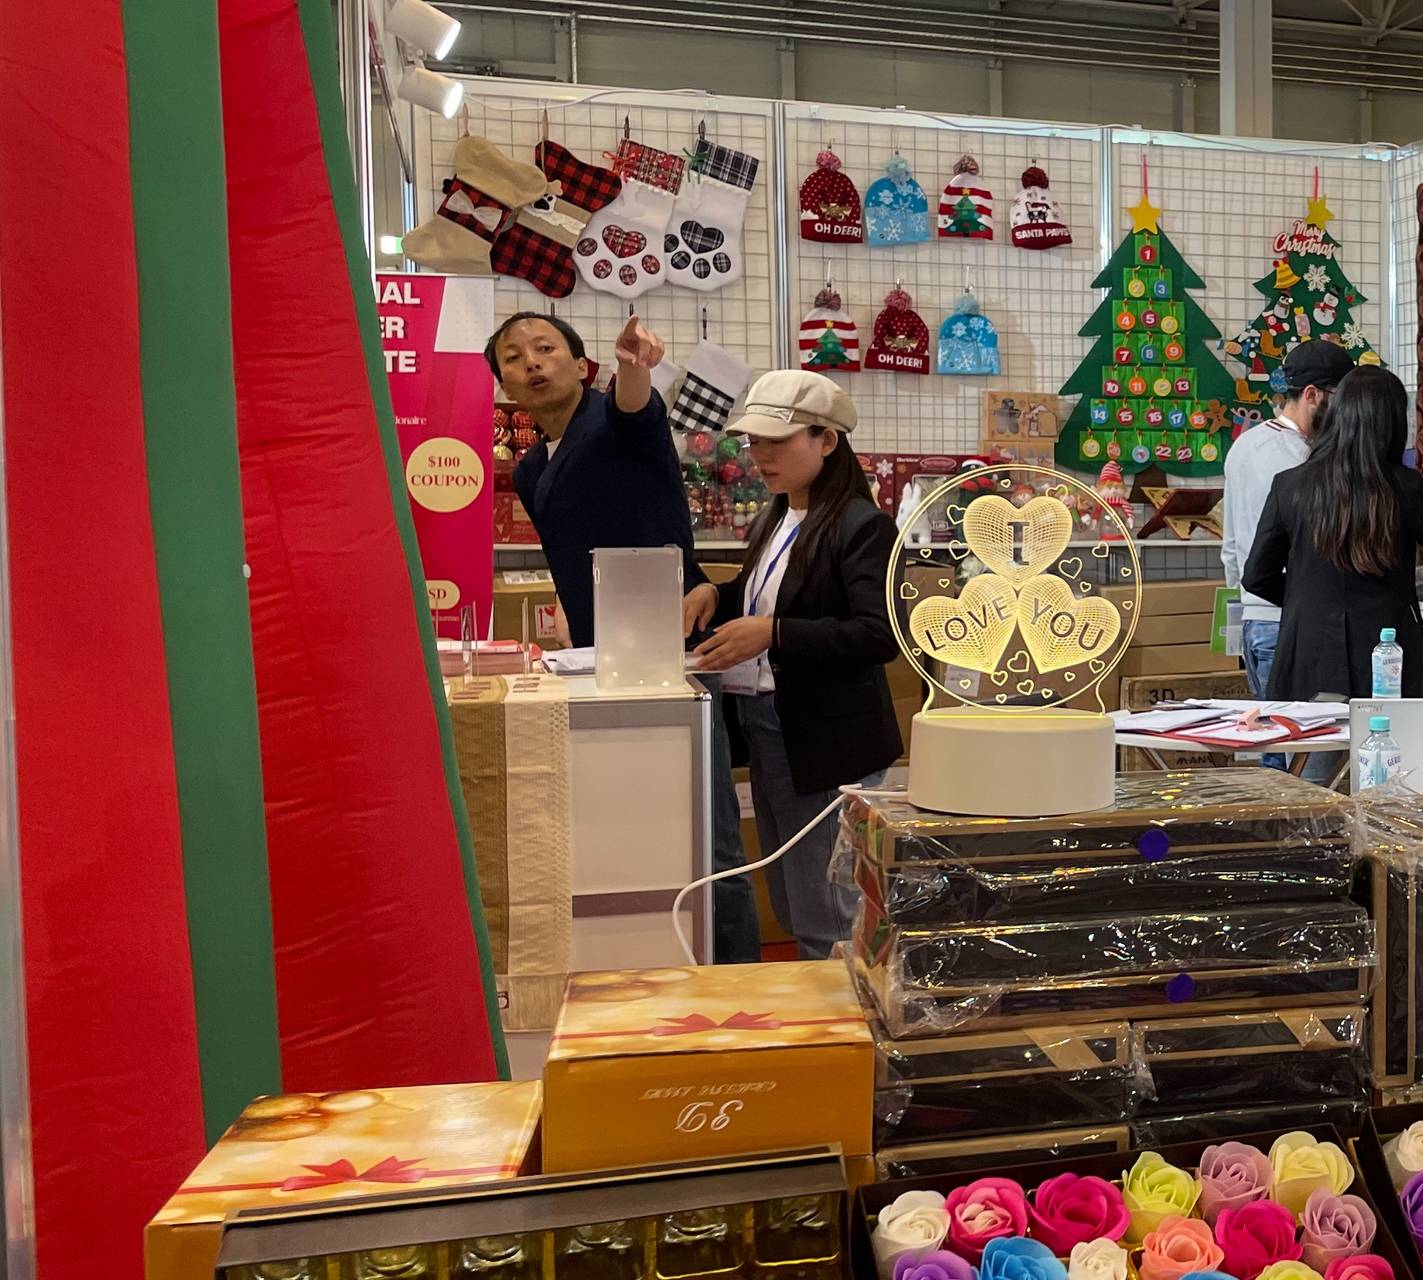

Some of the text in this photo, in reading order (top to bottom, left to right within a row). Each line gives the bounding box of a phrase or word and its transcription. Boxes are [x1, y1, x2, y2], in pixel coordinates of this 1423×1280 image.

[814, 222, 862, 238] OH DEER!
[1015, 228, 1069, 239] SANTA PAWS
[1293, 220, 1327, 242] Merry
[1273, 231, 1337, 260] Christmas
[1144, 249, 1151, 260] 1
[1158, 284, 1165, 294] 3
[1121, 315, 1130, 326] 4
[1145, 313, 1155, 324] 5
[878, 353, 923, 369] OH DEER!
[1119, 347, 1179, 361] 7 8 9
[1106, 382, 1119, 393] 10
[1132, 381, 1142, 392] 11
[1177, 380, 1189, 391] 13
[1093, 408, 1205, 424] 14 15 16 17 18
[1155, 446, 1172, 456] 22
[1176, 448, 1192, 460] 23
[428, 455, 460, 468] $100
[411, 474, 479, 487] COUPON
[1007, 521, 1030, 566] I
[925, 597, 1105, 651] LOVE YOU
[1150, 689, 1176, 704] 3D
[674, 1100, 743, 1133] 3D
